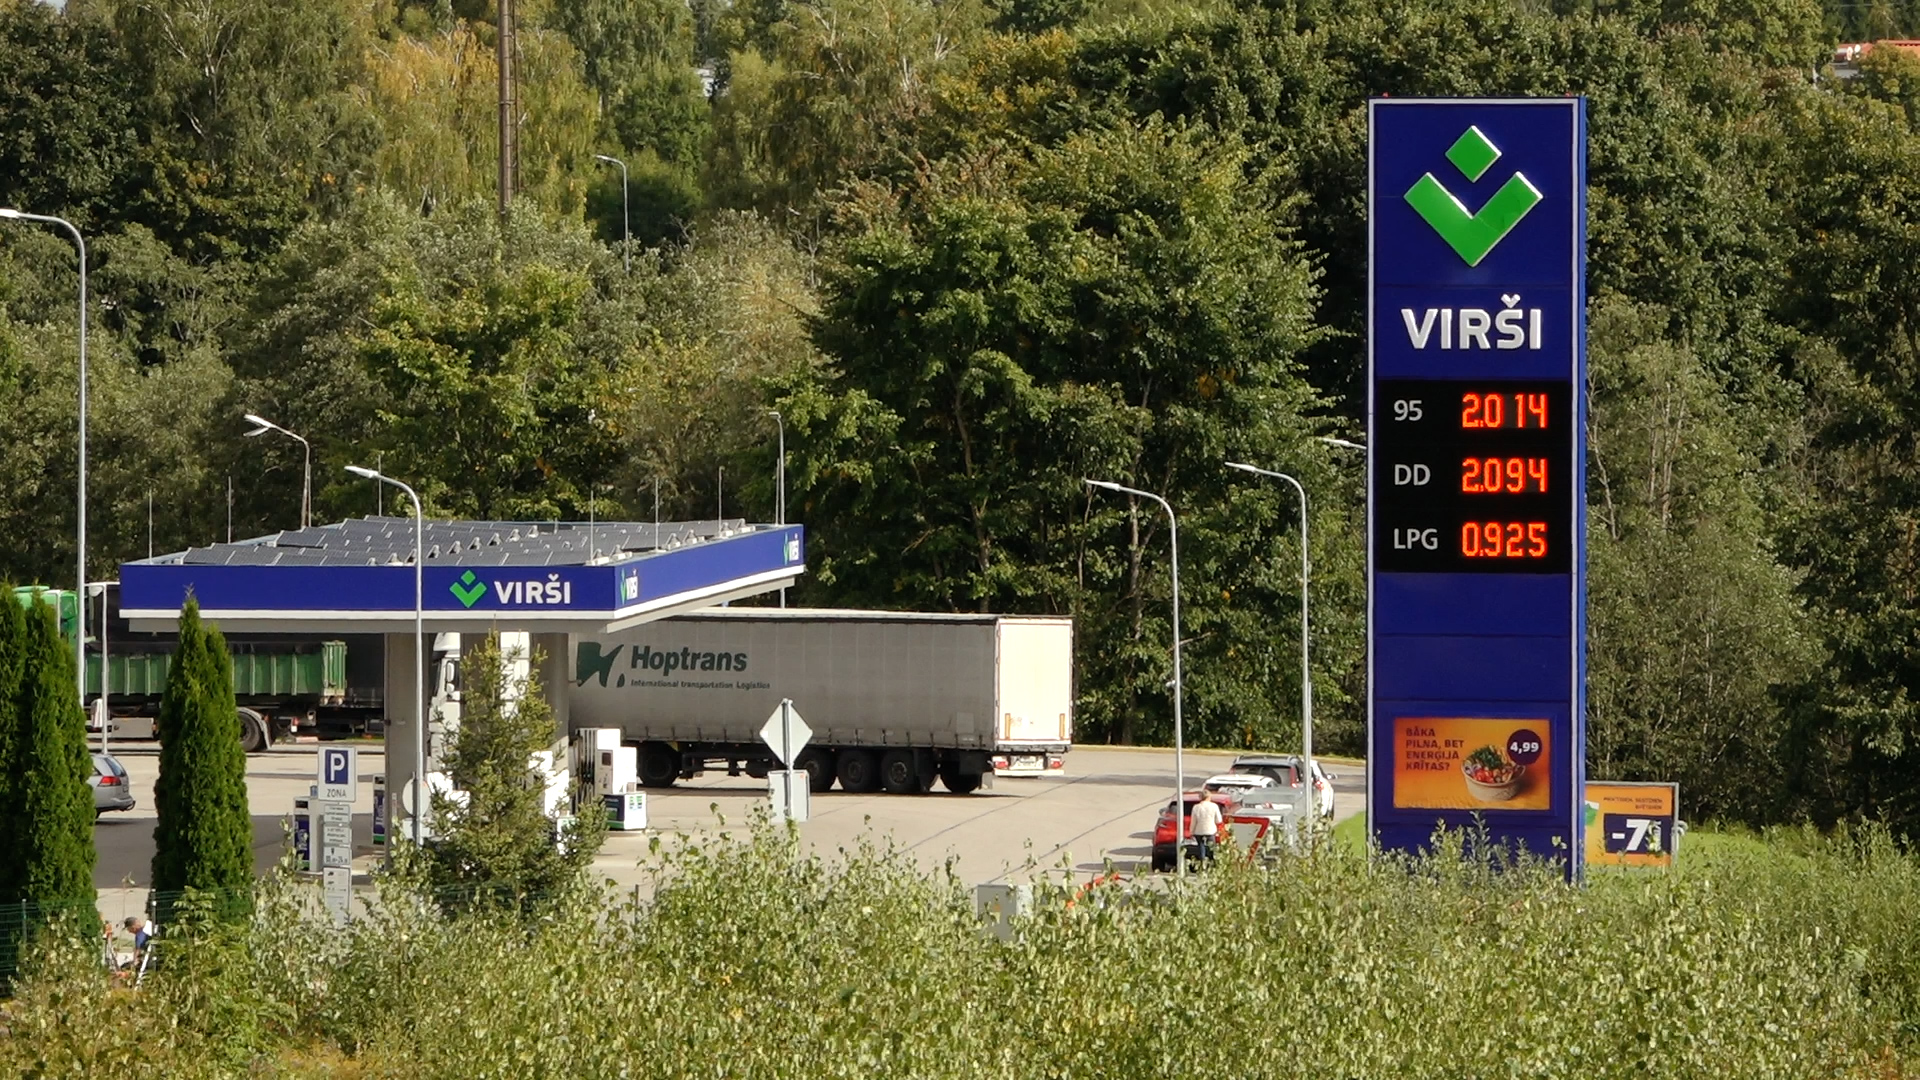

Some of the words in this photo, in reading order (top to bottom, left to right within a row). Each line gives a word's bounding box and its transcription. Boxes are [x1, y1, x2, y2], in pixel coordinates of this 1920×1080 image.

[1401, 294, 1542, 349] VIRŠI
[1394, 400, 1423, 421] 95
[1462, 394, 1548, 428] 2.014
[1394, 464, 1431, 485] DD
[1462, 458, 1548, 493] 2.094
[1394, 528, 1438, 549] LPG
[1462, 522, 1547, 557] 0.925
[494, 573, 571, 604] VIRŠI
[631, 645, 748, 676] Hoptrans
[631, 679, 679, 688] International
[681, 681, 733, 689] transportation
[736, 681, 770, 691] Logistics
[1406, 726, 1435, 737] BĀKA
[1406, 740, 1441, 749] PILNA,
[1444, 740, 1464, 748] BET
[1510, 742, 1539, 754] 4,99
[330, 753, 345, 781] P
[327, 789, 347, 798] ZONA
